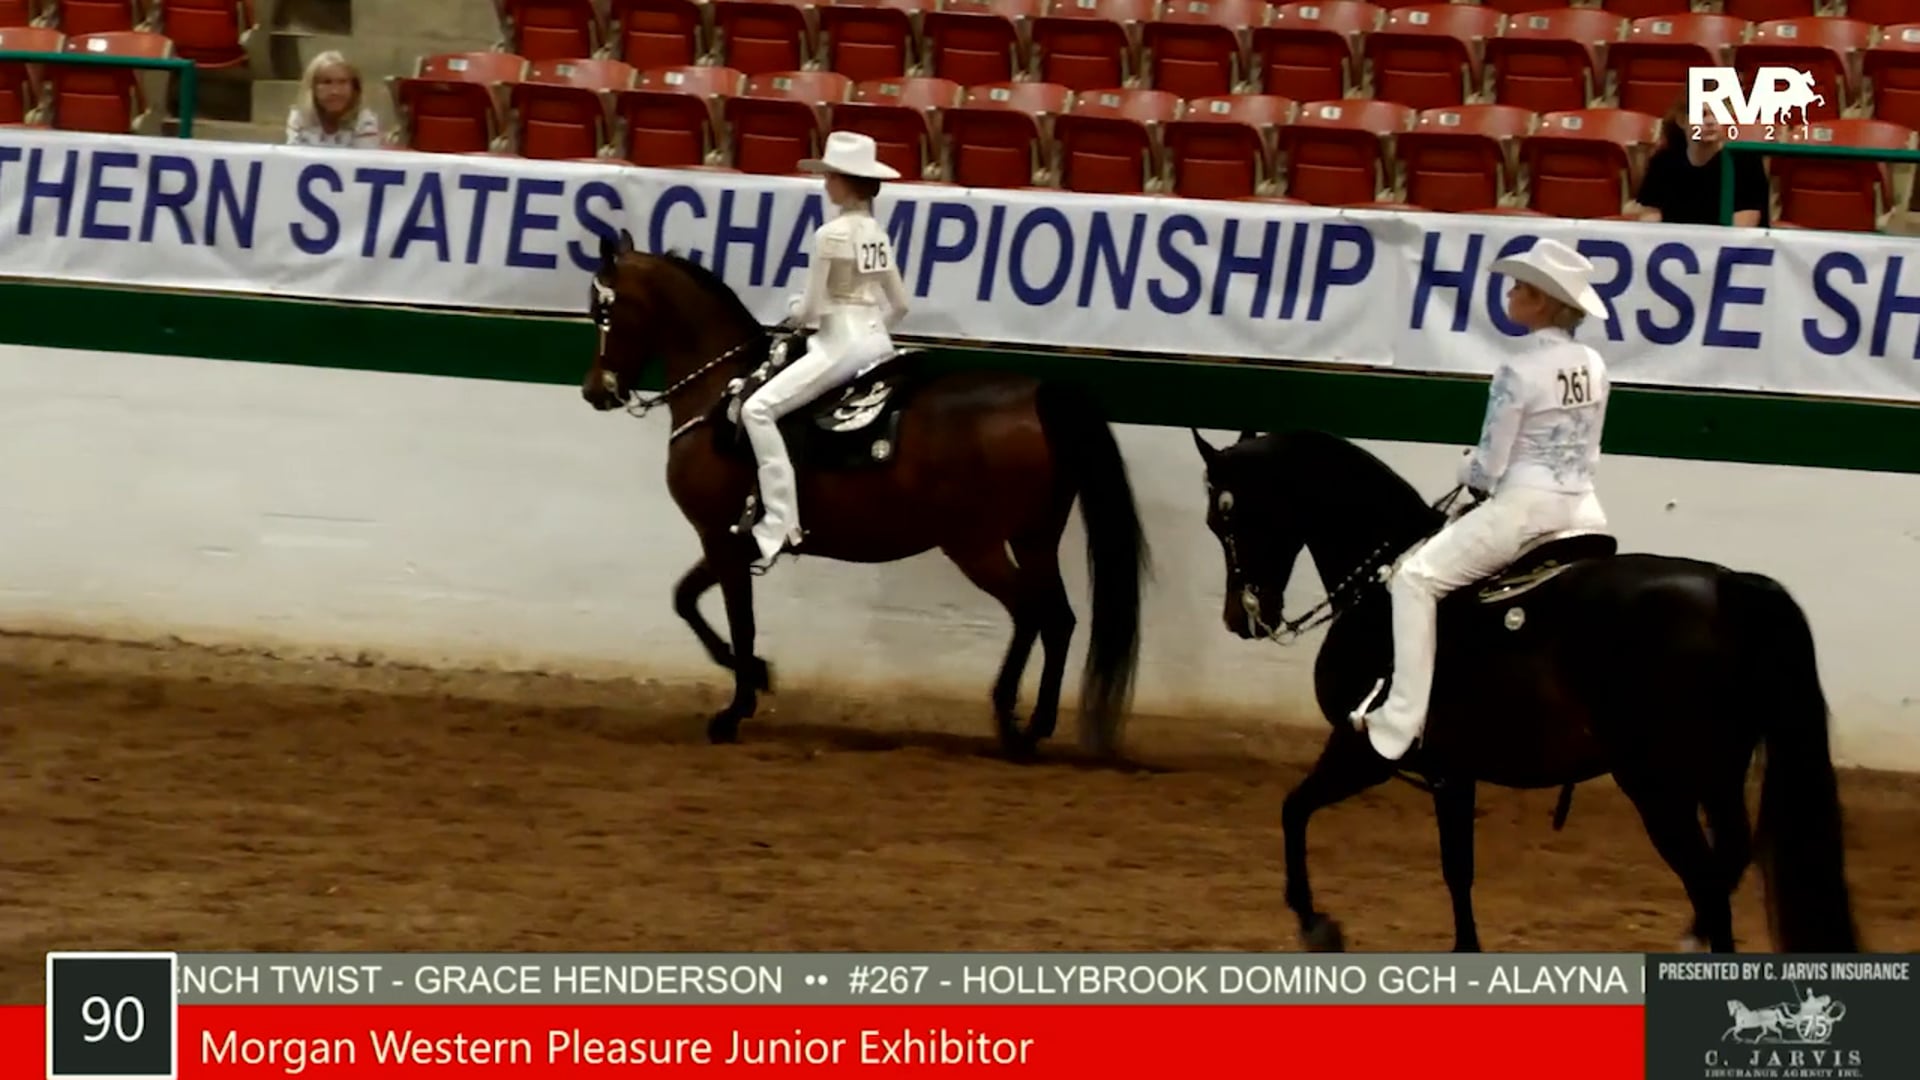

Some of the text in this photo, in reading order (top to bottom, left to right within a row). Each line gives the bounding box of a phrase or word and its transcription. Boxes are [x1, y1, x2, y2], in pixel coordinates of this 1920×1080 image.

[289, 164, 624, 273] STATES
[861, 243, 889, 270] 276
[1556, 365, 1592, 406] 267
